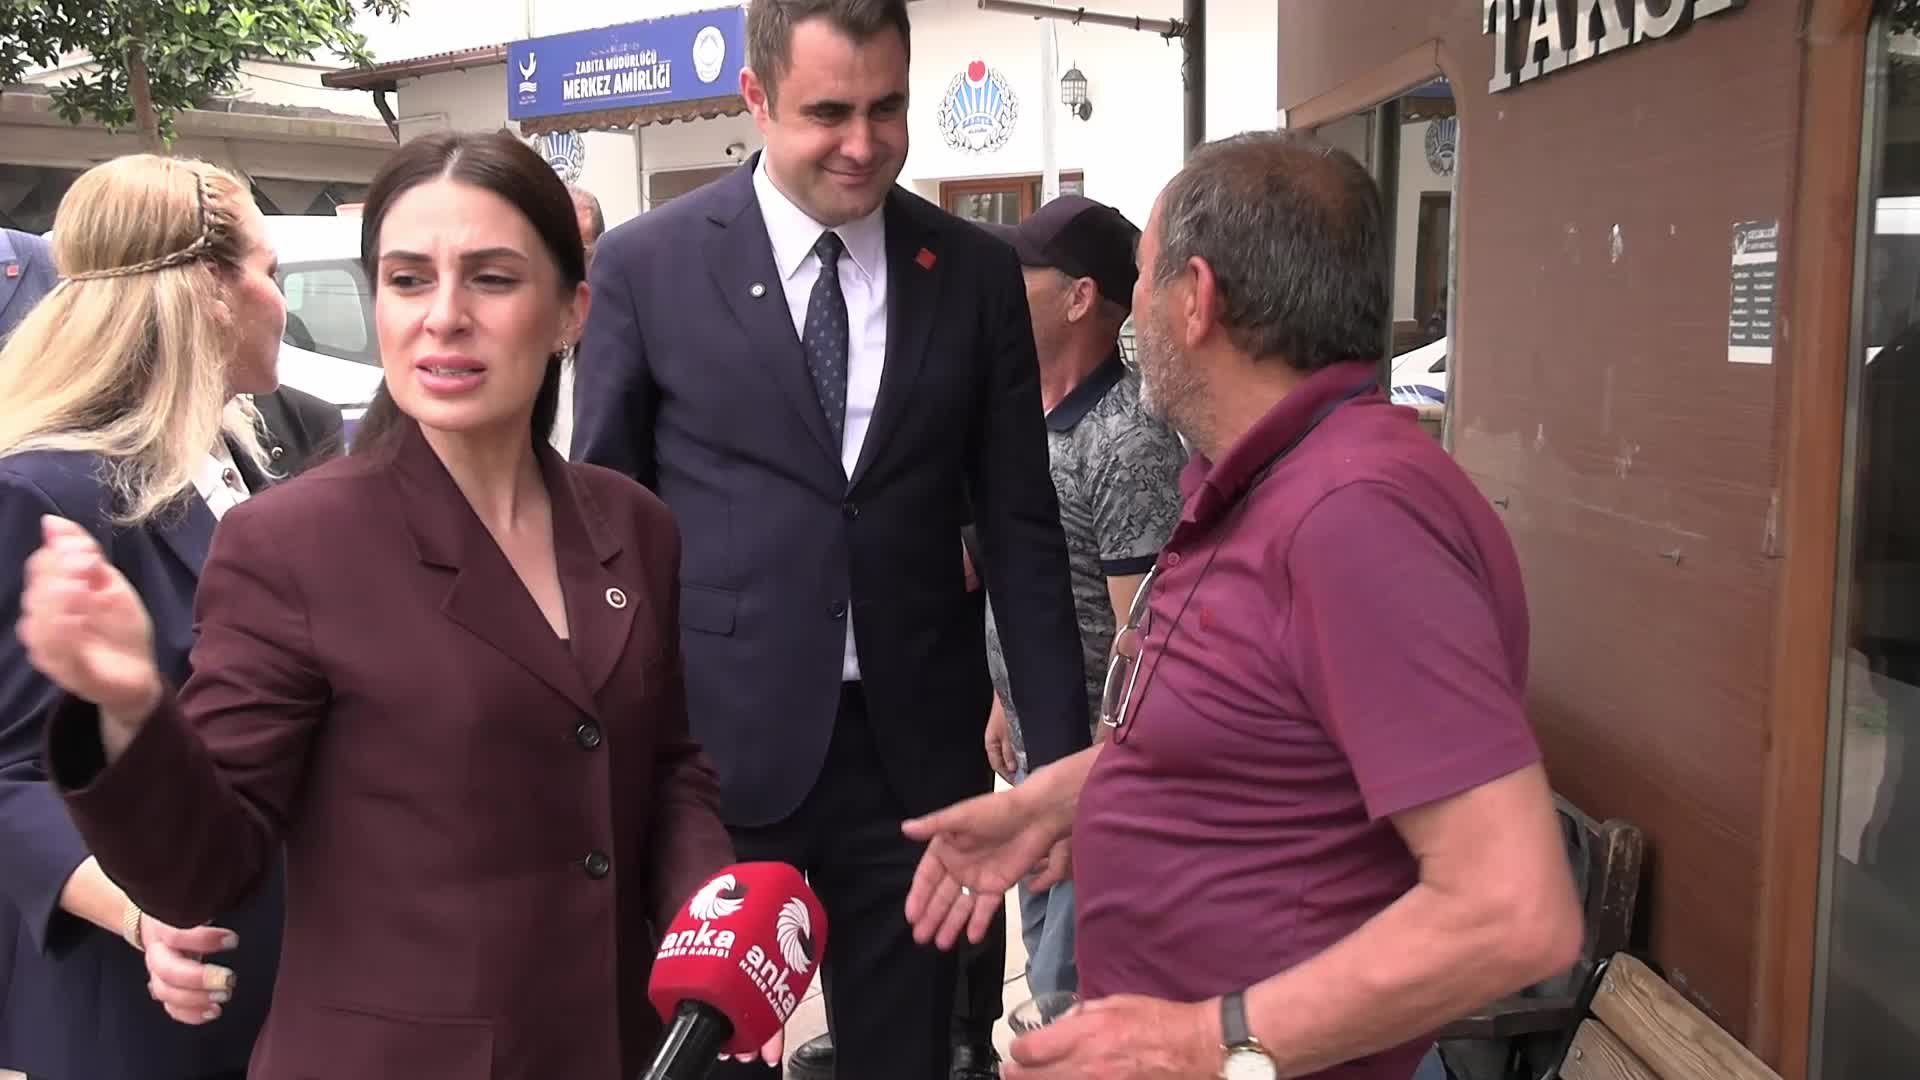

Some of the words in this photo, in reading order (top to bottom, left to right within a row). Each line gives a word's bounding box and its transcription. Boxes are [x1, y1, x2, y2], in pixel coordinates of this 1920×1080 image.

[576, 58, 605, 75] ZABITA
[606, 47, 658, 71] MÜDÜRLÜĞÜ
[1482, 0, 1732, 94] TAKS
[563, 74, 611, 100] MERKEZ
[613, 62, 671, 94] AMİRLİĞİ
[661, 921, 735, 950] anka
[688, 946, 730, 959] AJANSI
[746, 945, 796, 1017] anka
